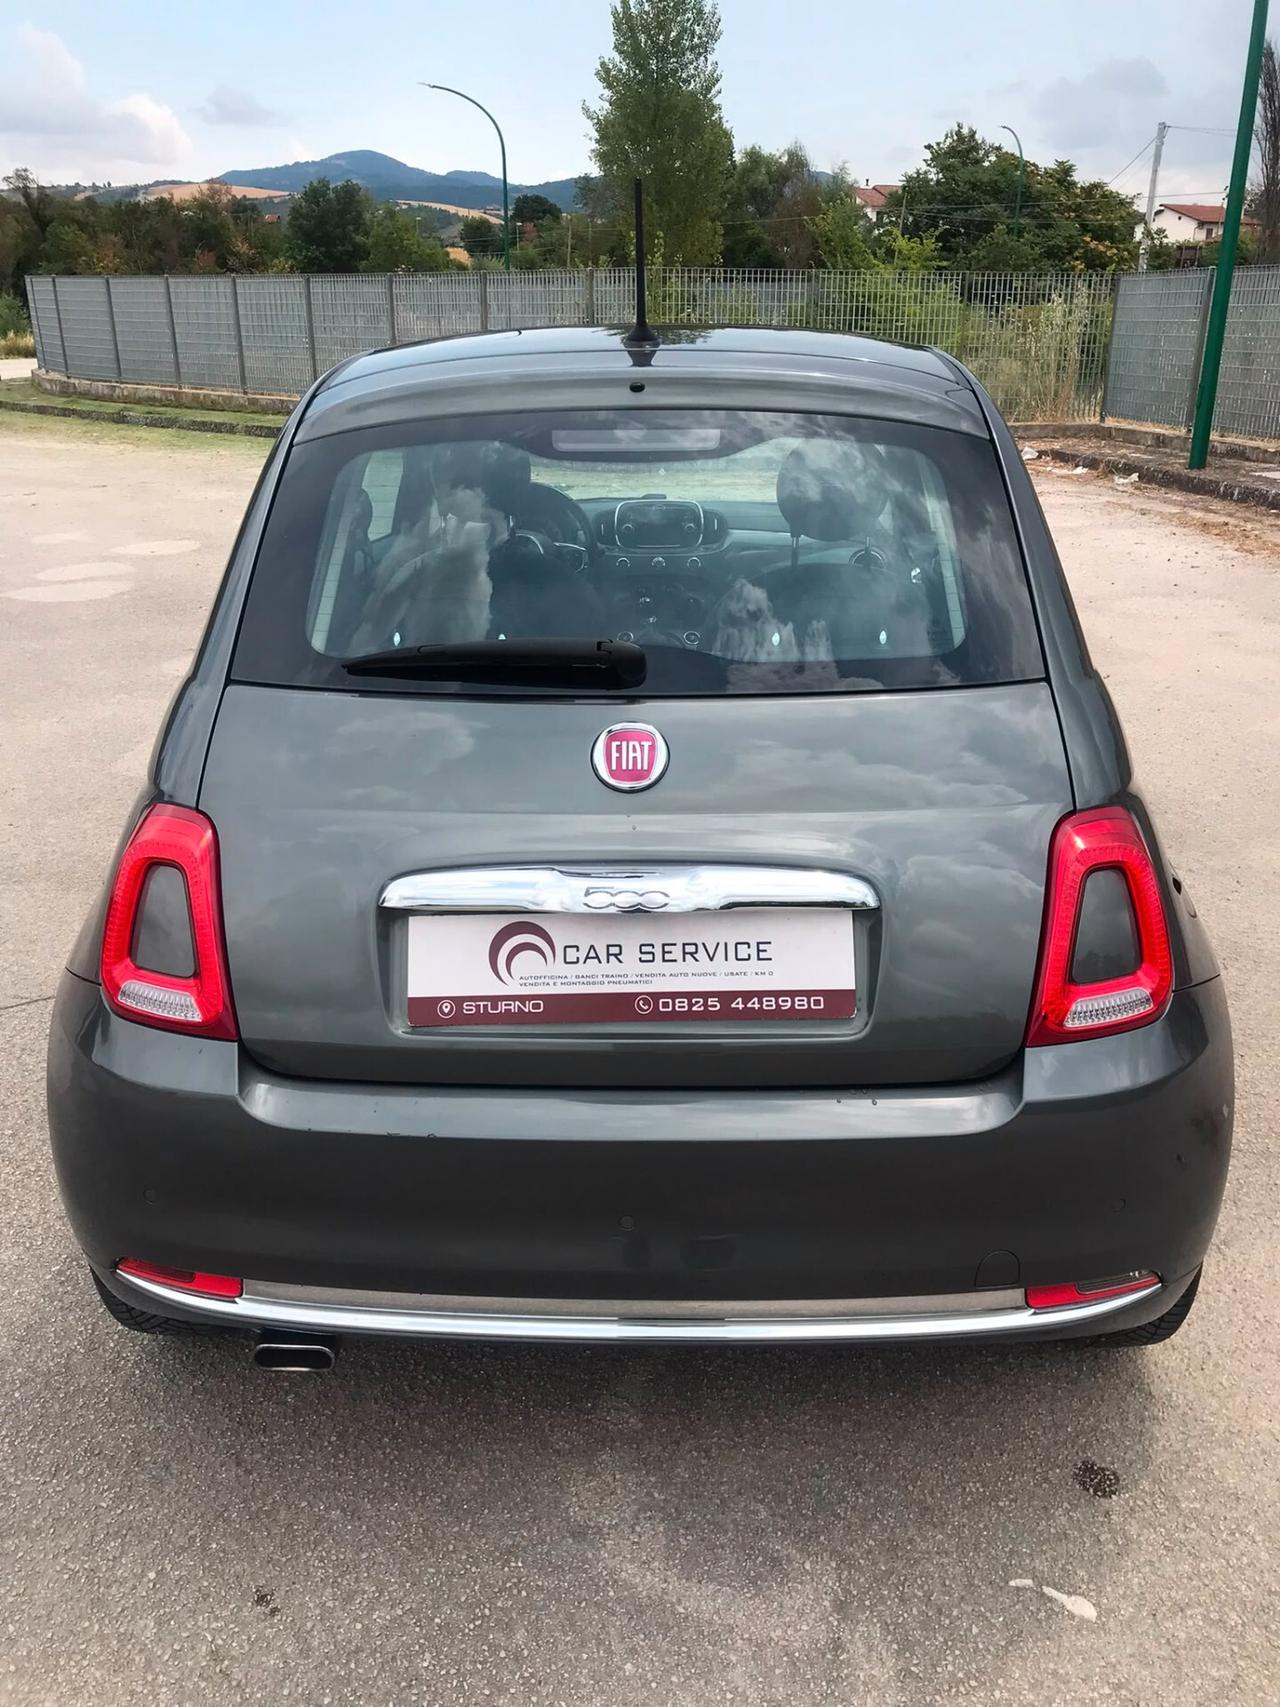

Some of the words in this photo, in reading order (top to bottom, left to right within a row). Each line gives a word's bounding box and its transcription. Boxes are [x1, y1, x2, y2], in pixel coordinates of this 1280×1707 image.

[611, 740, 652, 771] FIAT
[583, 886, 670, 909] 500
[563, 944, 624, 965] CAR
[639, 941, 772, 963] SERVICE
[463, 1000, 544, 1014] STURNO
[659, 997, 720, 1012] 0825
[730, 995, 824, 1010] 448980
